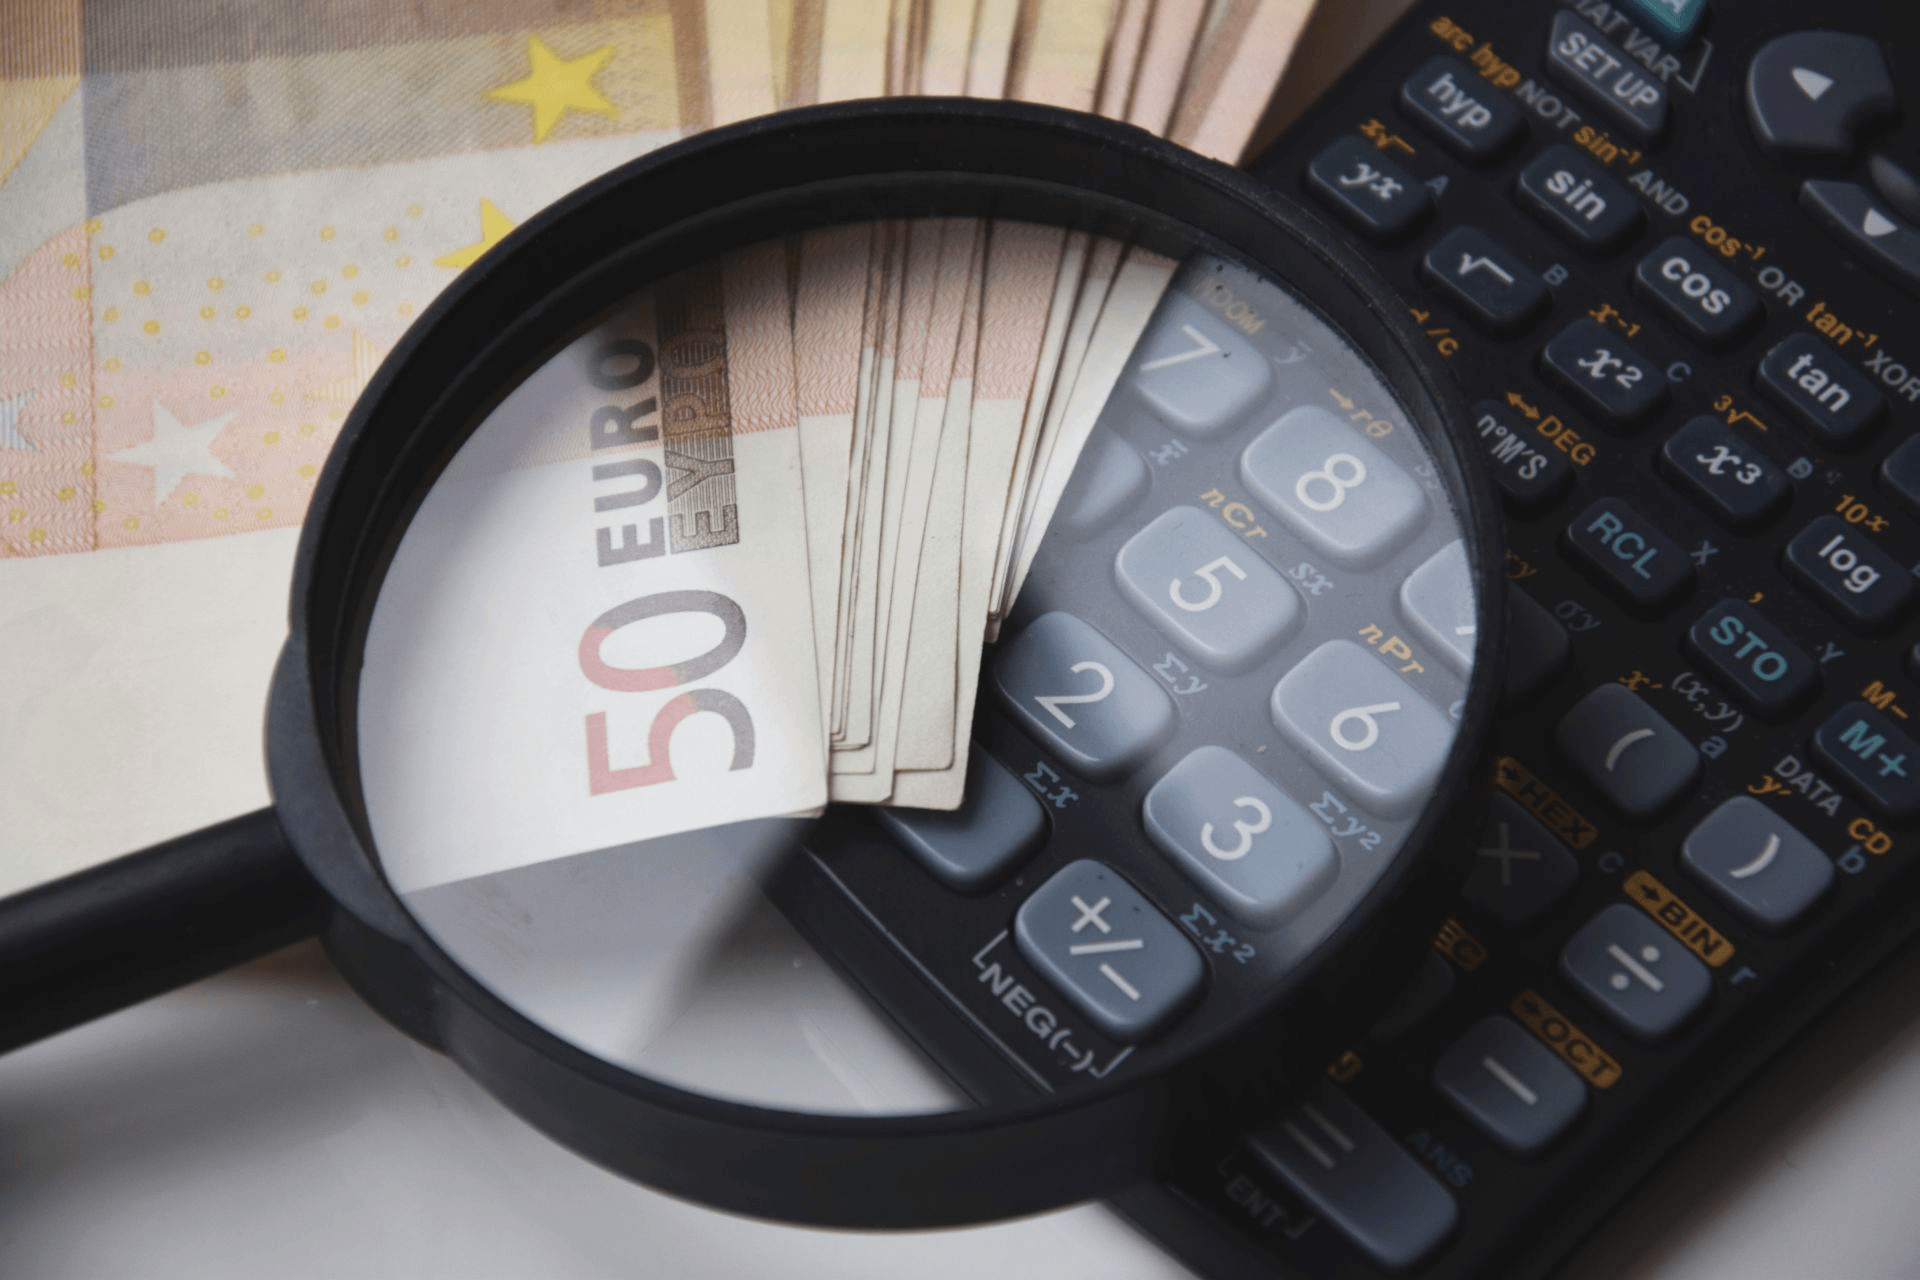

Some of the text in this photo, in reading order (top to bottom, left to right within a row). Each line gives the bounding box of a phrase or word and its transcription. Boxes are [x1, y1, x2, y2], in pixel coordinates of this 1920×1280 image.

[1430, 16, 1522, 88] arc hyp
[1559, 32, 1660, 107] SET UP
[1624, 27, 1681, 82] VAR
[1428, 72, 1491, 129] hyp
[1516, 79, 1580, 129] NOT
[1426, 175, 1449, 195] A
[1546, 168, 1607, 222] sin
[1629, 169, 1689, 215] AND
[1542, 264, 1569, 286] B
[1661, 257, 1731, 315] cos
[1758, 267, 1805, 306] OR
[1140, 324, 1222, 372] 7
[1666, 362, 1693, 383] C
[1785, 353, 1851, 414] tan
[587, 337, 667, 567] EURO
[1536, 415, 1596, 466] DEG
[1296, 453, 1366, 512] 8
[1200, 487, 1269, 540] nCr
[1587, 512, 1654, 579] RCL
[1817, 534, 1881, 595] log
[1169, 555, 1249, 613] 5
[1358, 622, 1425, 677] nPr
[1709, 615, 1786, 682] STO
[578, 588, 757, 797] 50
[1034, 660, 1115, 730] 2
[1330, 701, 1401, 752] 6
[1700, 737, 1727, 759] a
[1838, 719, 1907, 779] M+
[1520, 783, 1590, 840] HEX
[1773, 754, 1843, 817] DATA
[1201, 796, 1273, 861] 3
[1847, 817, 1892, 856] CD
[1837, 846, 1866, 874] b
[1657, 899, 1718, 958] BIN
[1540, 1016, 1615, 1080] OCT
[1406, 1130, 1472, 1187] ANS
[1225, 1174, 1290, 1233] ENT
